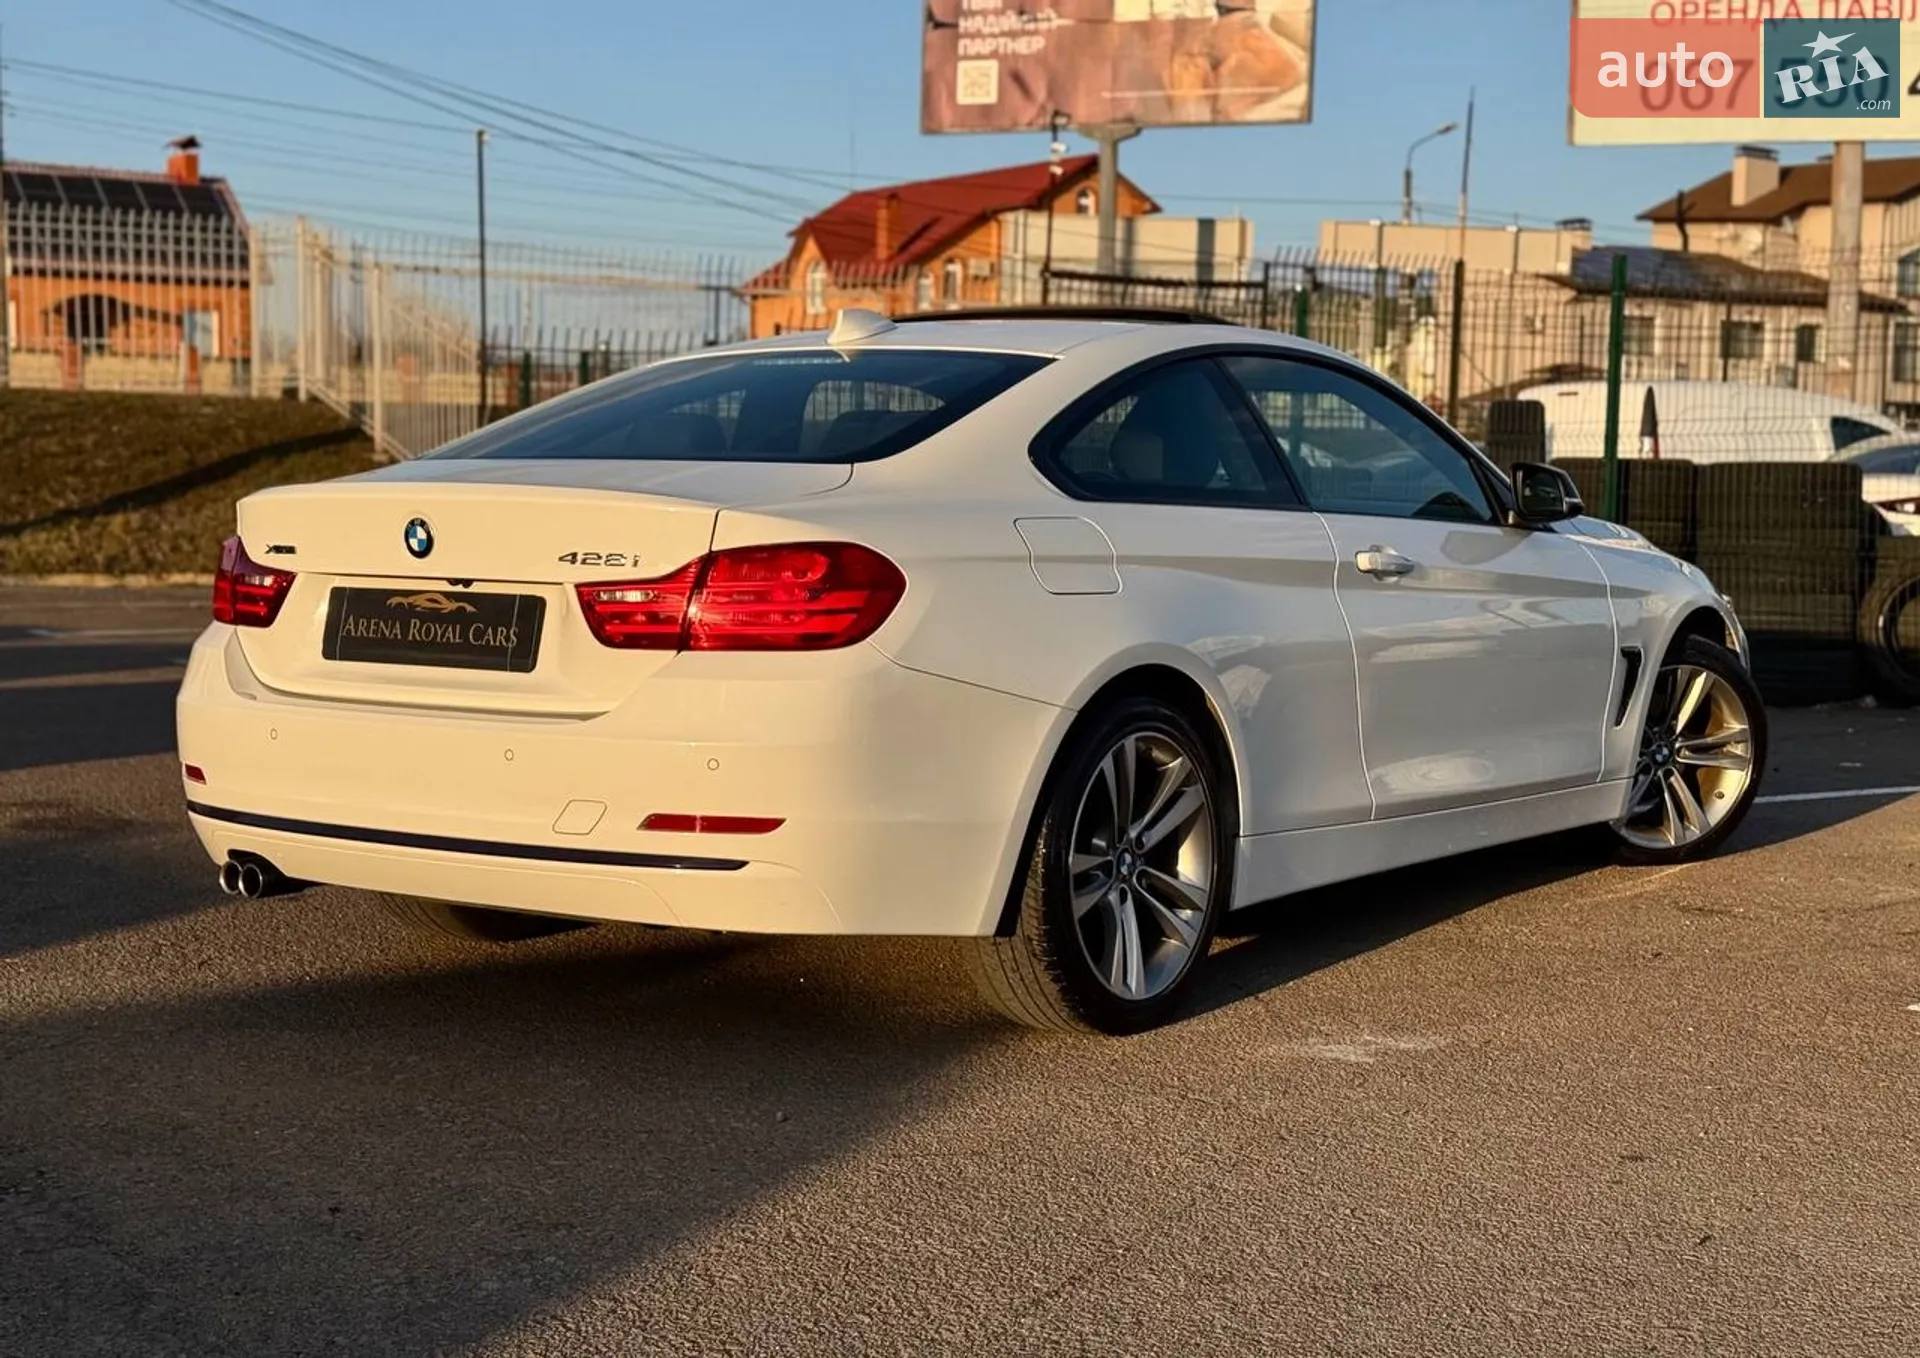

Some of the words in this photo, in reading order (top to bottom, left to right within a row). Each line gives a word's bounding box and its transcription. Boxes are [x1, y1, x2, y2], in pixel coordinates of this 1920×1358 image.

[1651, 0, 1803, 32] ОРЕНДА
[958, 36, 1046, 57] ПАРТНЕР
[343, 615, 401, 640] ARENA
[408, 618, 464, 643] ROYAL
[469, 623, 519, 647] CARS
